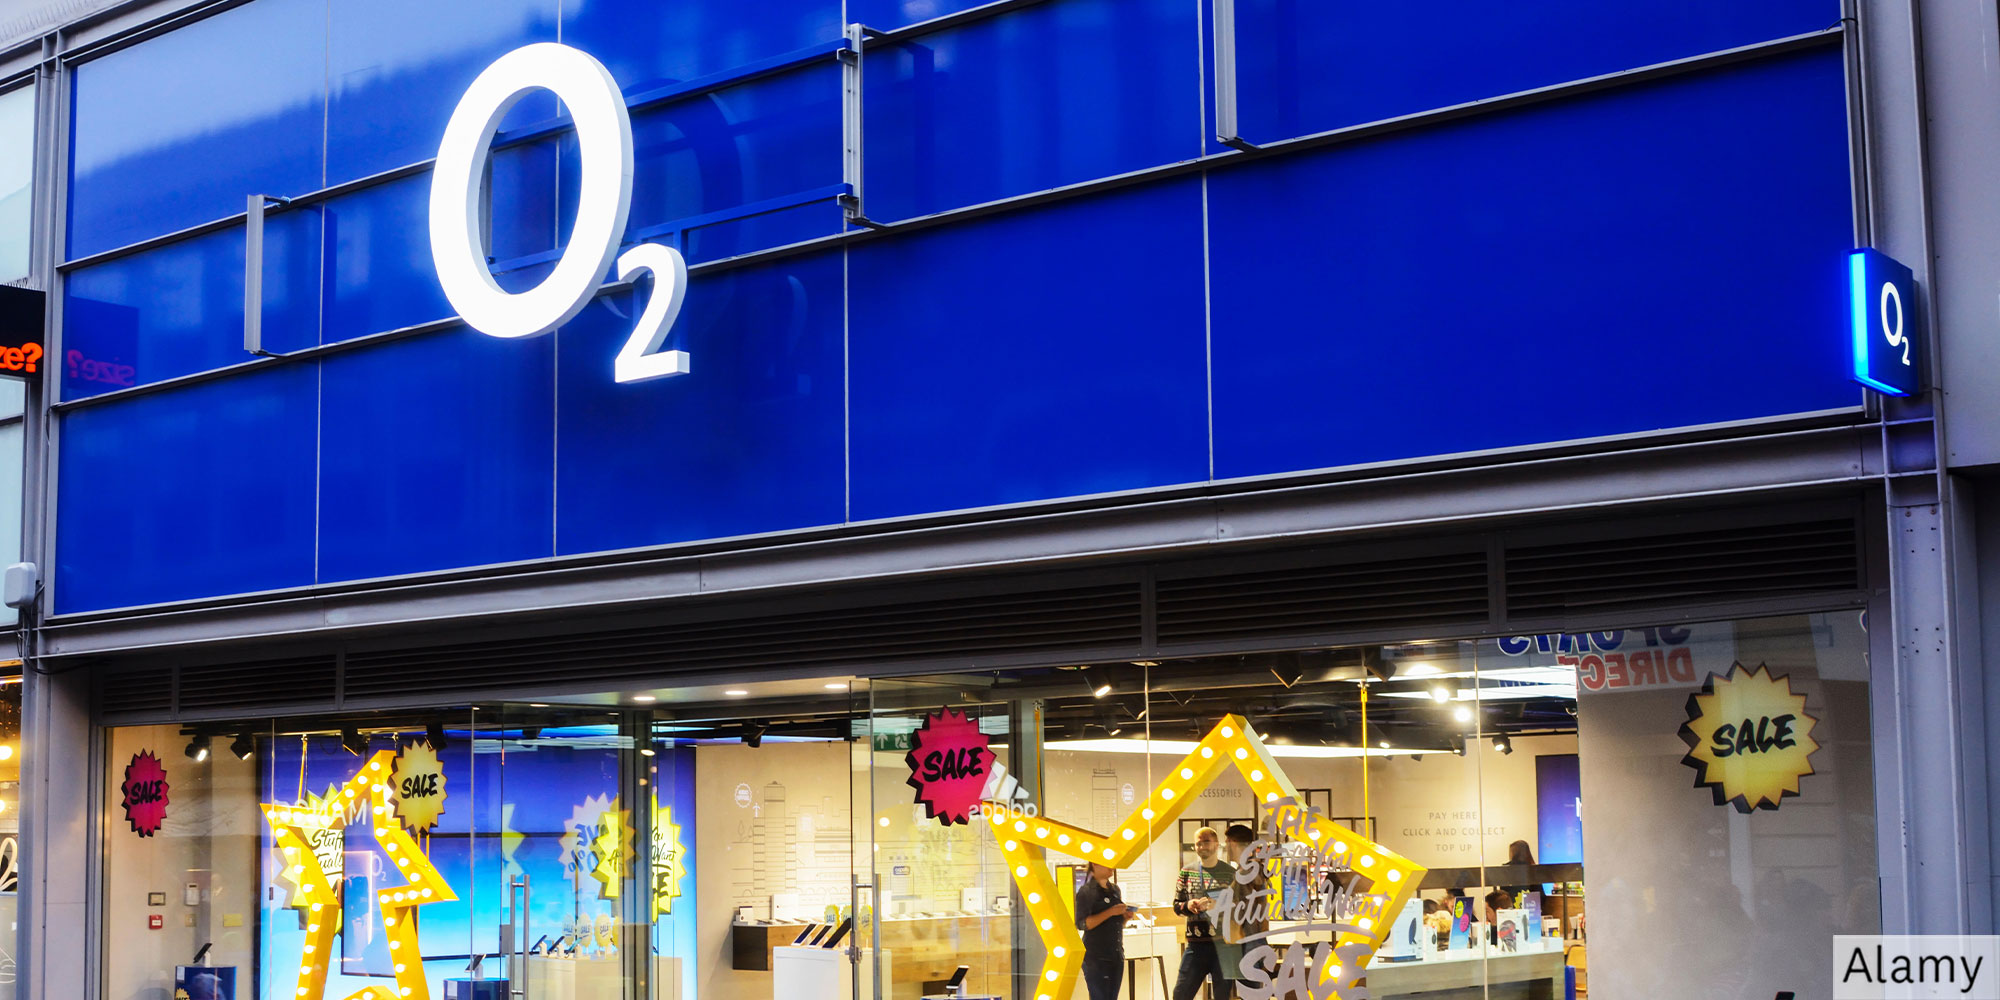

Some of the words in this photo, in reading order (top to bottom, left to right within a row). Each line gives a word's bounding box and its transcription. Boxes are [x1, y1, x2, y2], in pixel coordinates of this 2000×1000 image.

[429, 42, 690, 383] O2
[1880, 281, 1911, 366] O2
[1710, 714, 1797, 757] SALE
[922, 747, 984, 783] SALE
[130, 780, 162, 805] SALE
[401, 773, 438, 800] SALE
[1199, 788, 1242, 798] CESSORIES
[1262, 796, 1321, 838] THE
[1402, 828, 1431, 837] CLICK
[1436, 828, 1457, 837] AND
[1462, 827, 1506, 836] COLLECT
[1429, 812, 1447, 820] PAY
[1452, 812, 1478, 820] HERE
[1235, 838, 1312, 886] Stuff
[1436, 843, 1455, 852] TOP
[1459, 843, 1473, 852] UP
[1206, 885, 1318, 943] Actually
[1317, 874, 1392, 923] Want
